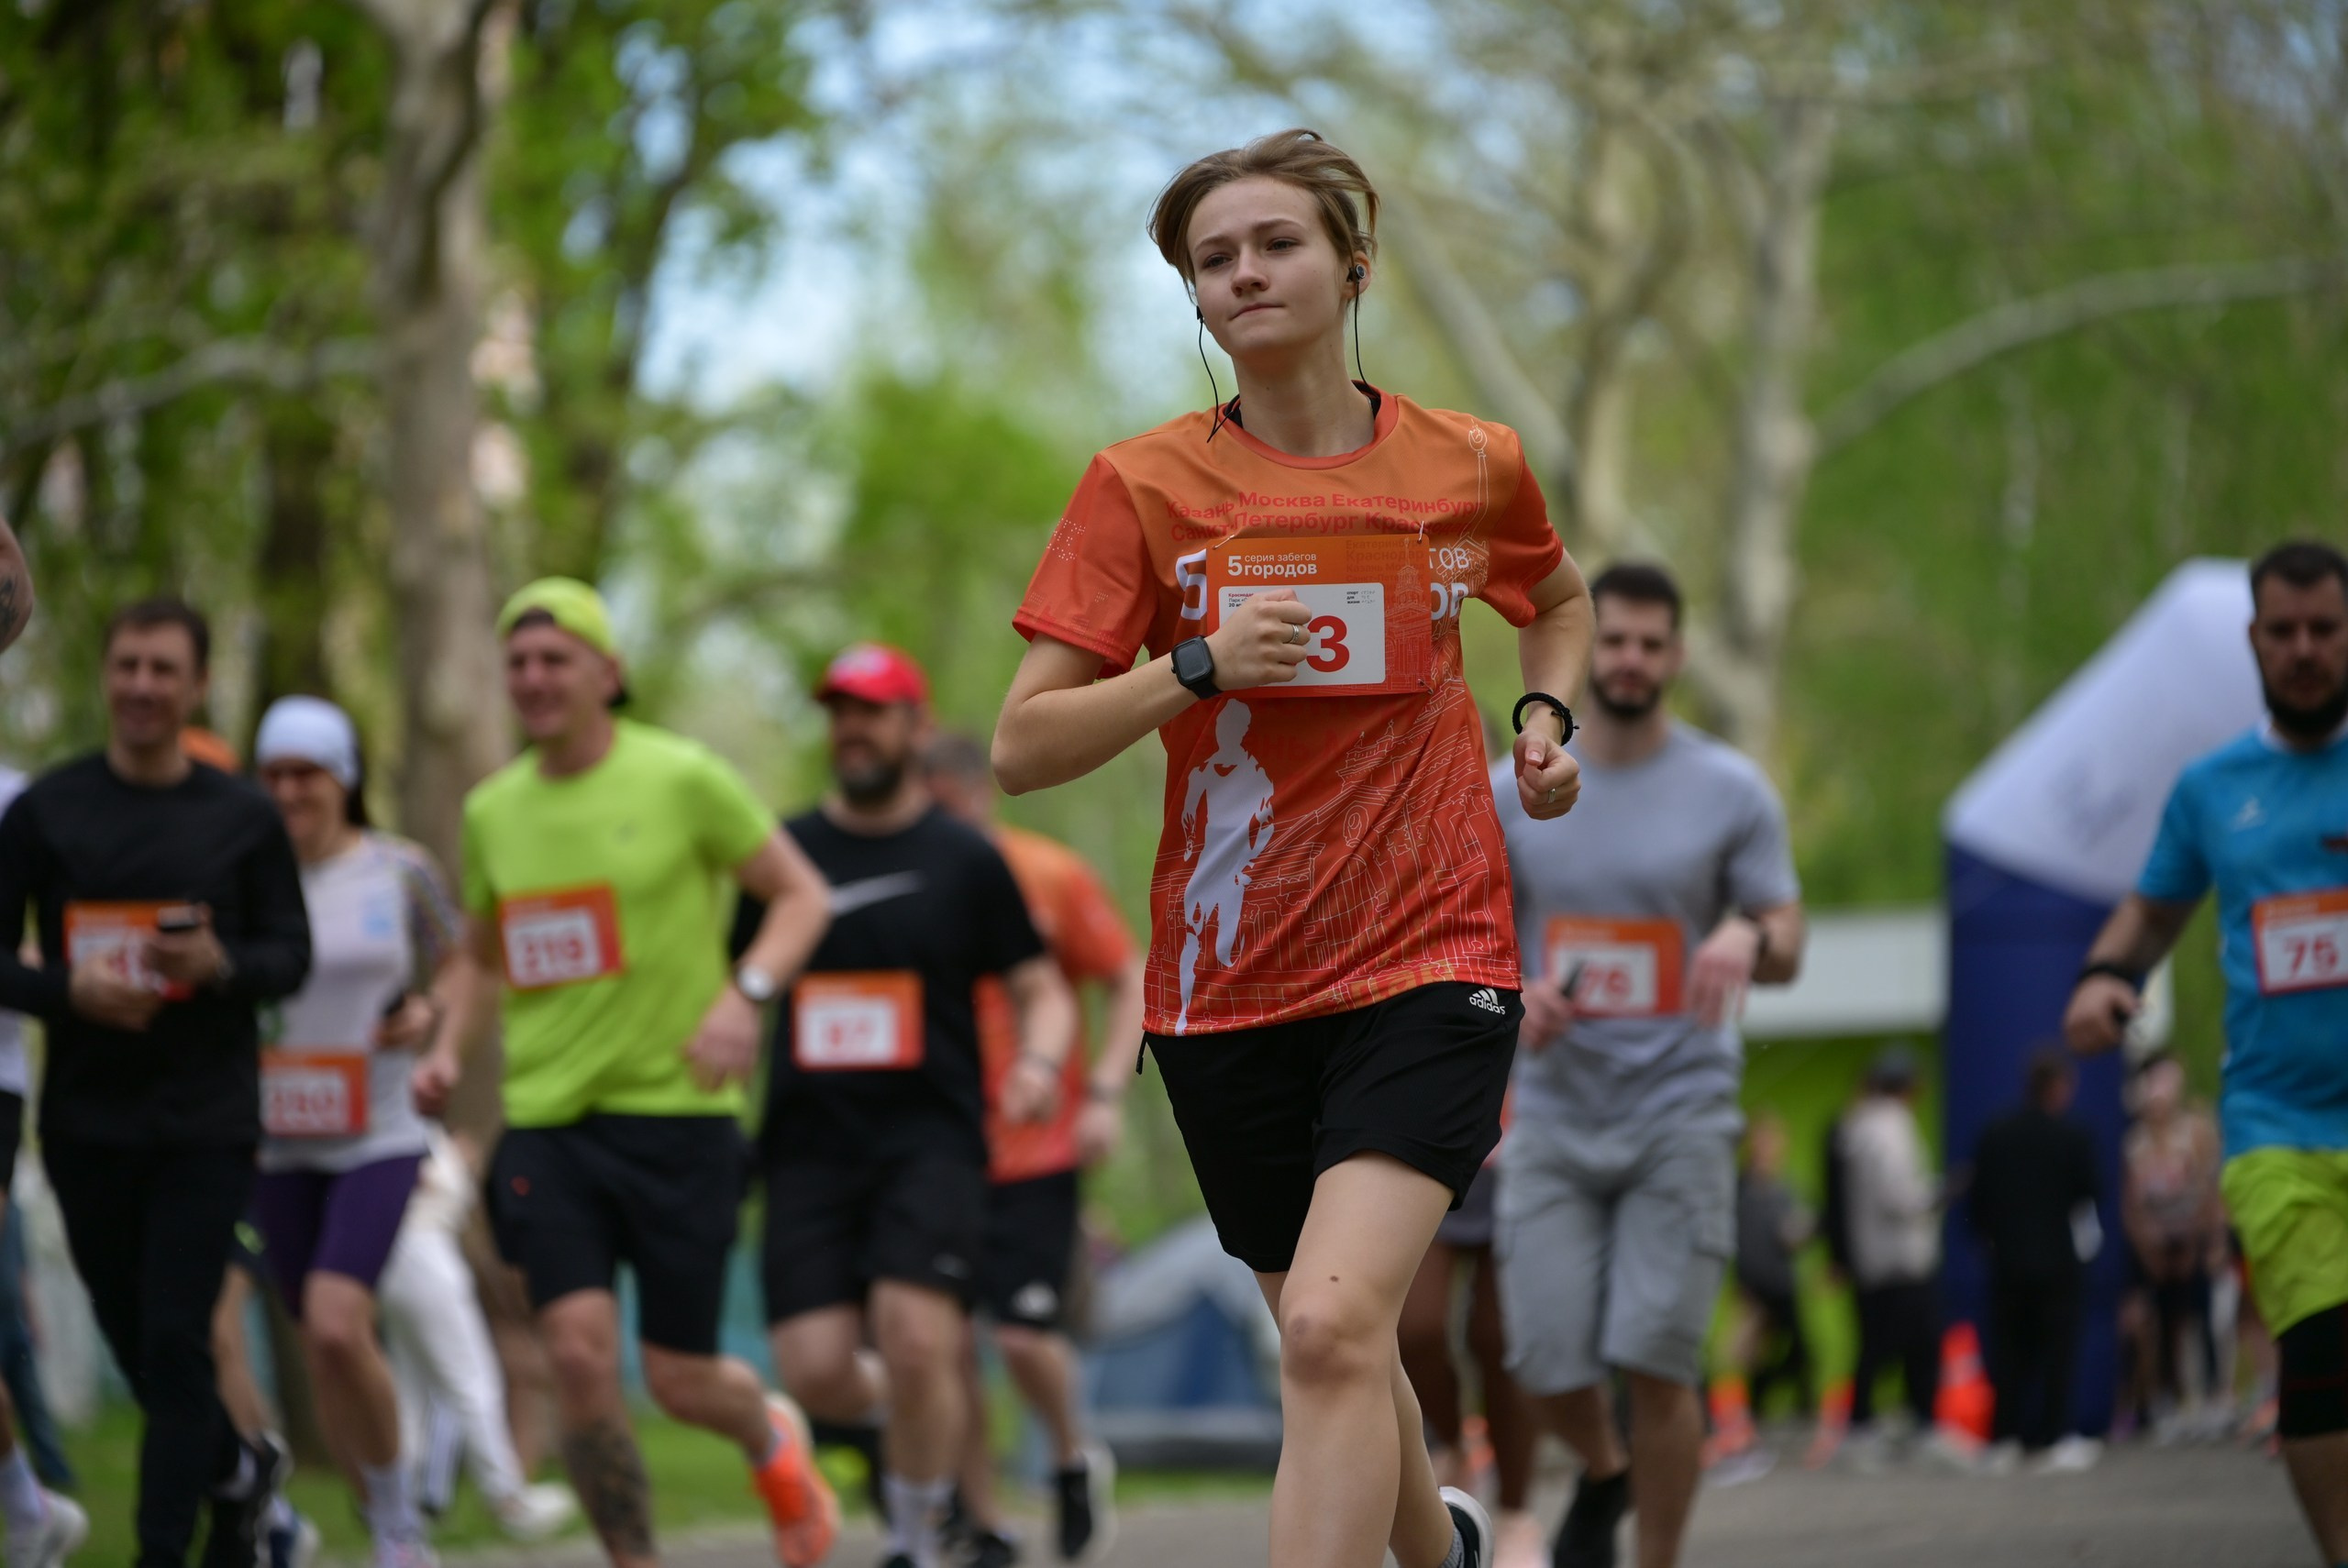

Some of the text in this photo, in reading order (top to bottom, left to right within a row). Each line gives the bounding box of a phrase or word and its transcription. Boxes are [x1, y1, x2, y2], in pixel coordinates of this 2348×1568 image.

[1166, 491, 1484, 519] Казань Москва Екатеринбург
[1227, 555, 1318, 579] 5 городов
[1245, 553, 1317, 563] серия забегов
[1468, 996, 1506, 1015] adidas
